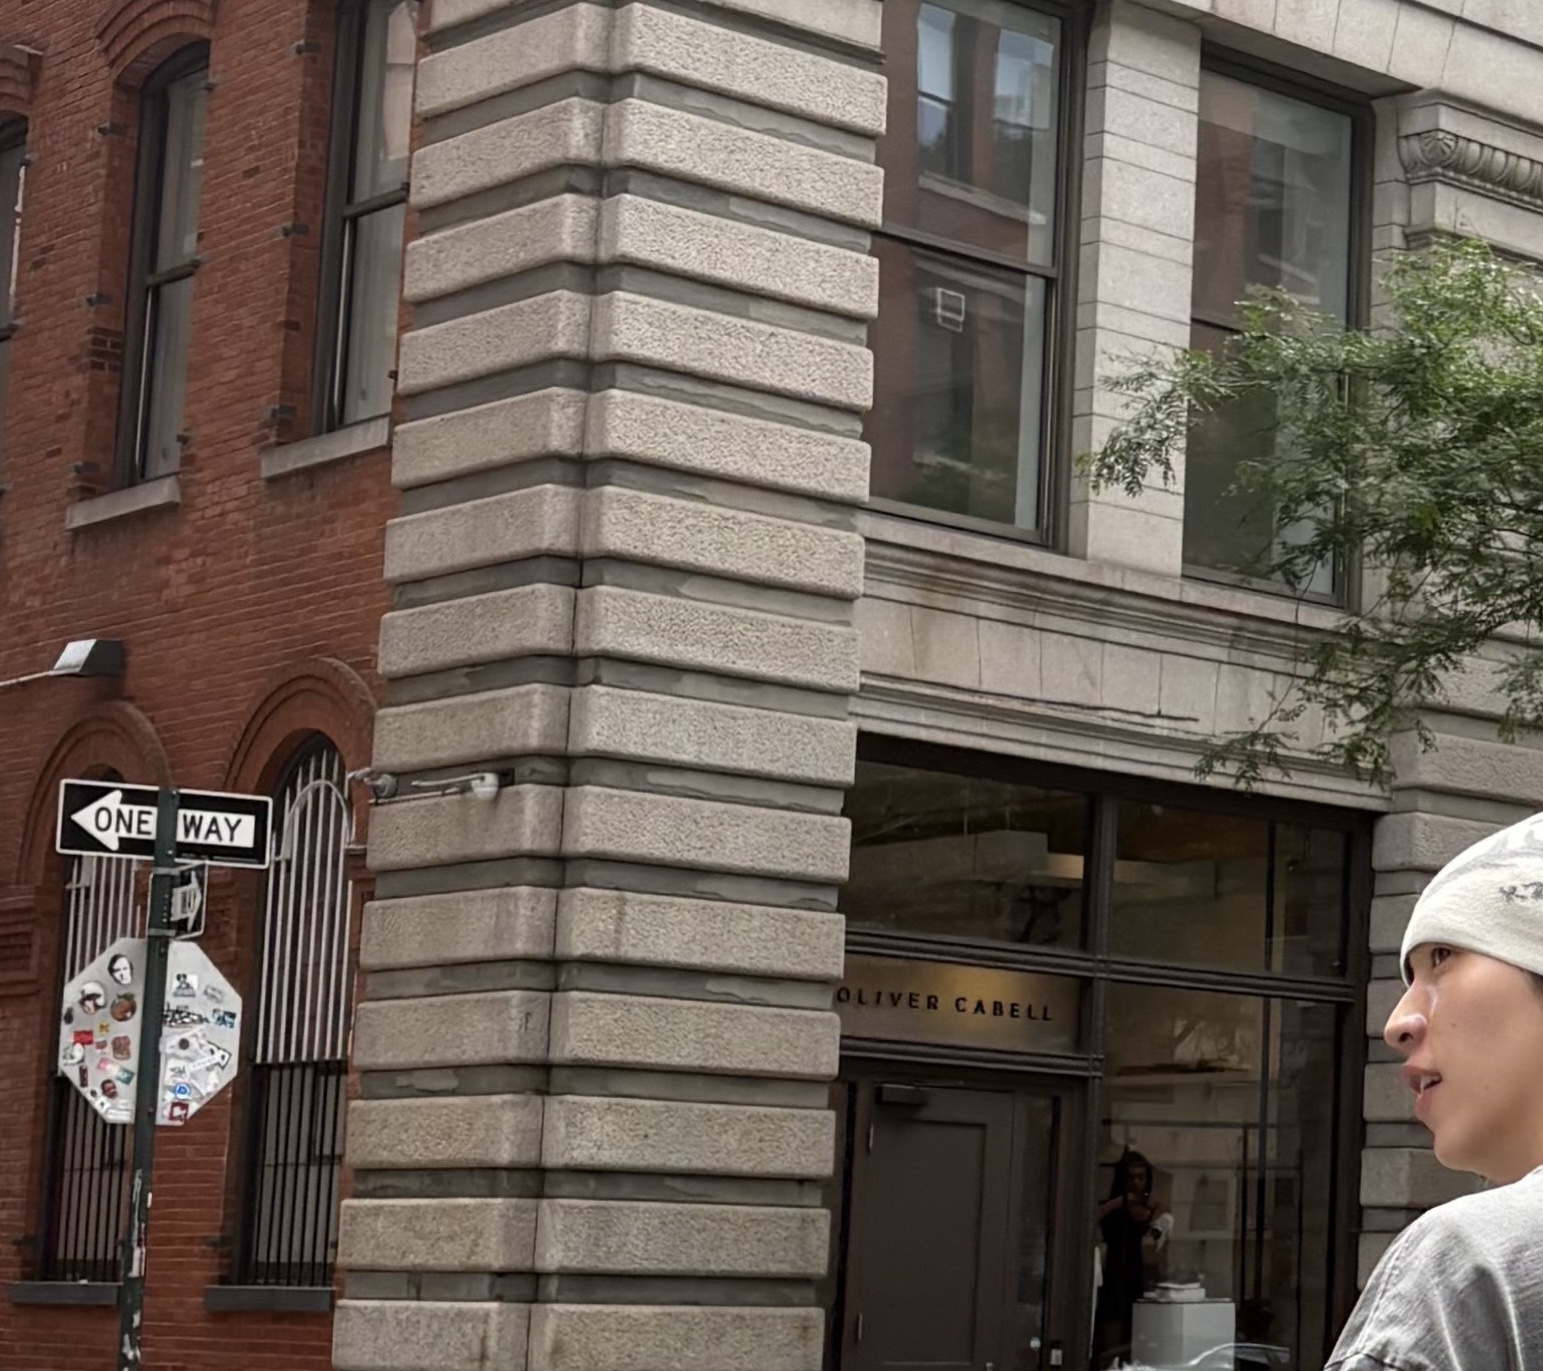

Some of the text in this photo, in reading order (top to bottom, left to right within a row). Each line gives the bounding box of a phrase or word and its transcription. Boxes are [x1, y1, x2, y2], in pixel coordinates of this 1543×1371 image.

[94, 806, 242, 843] ONE WAY
[836, 986, 1053, 1022] OLIVER CABELL
